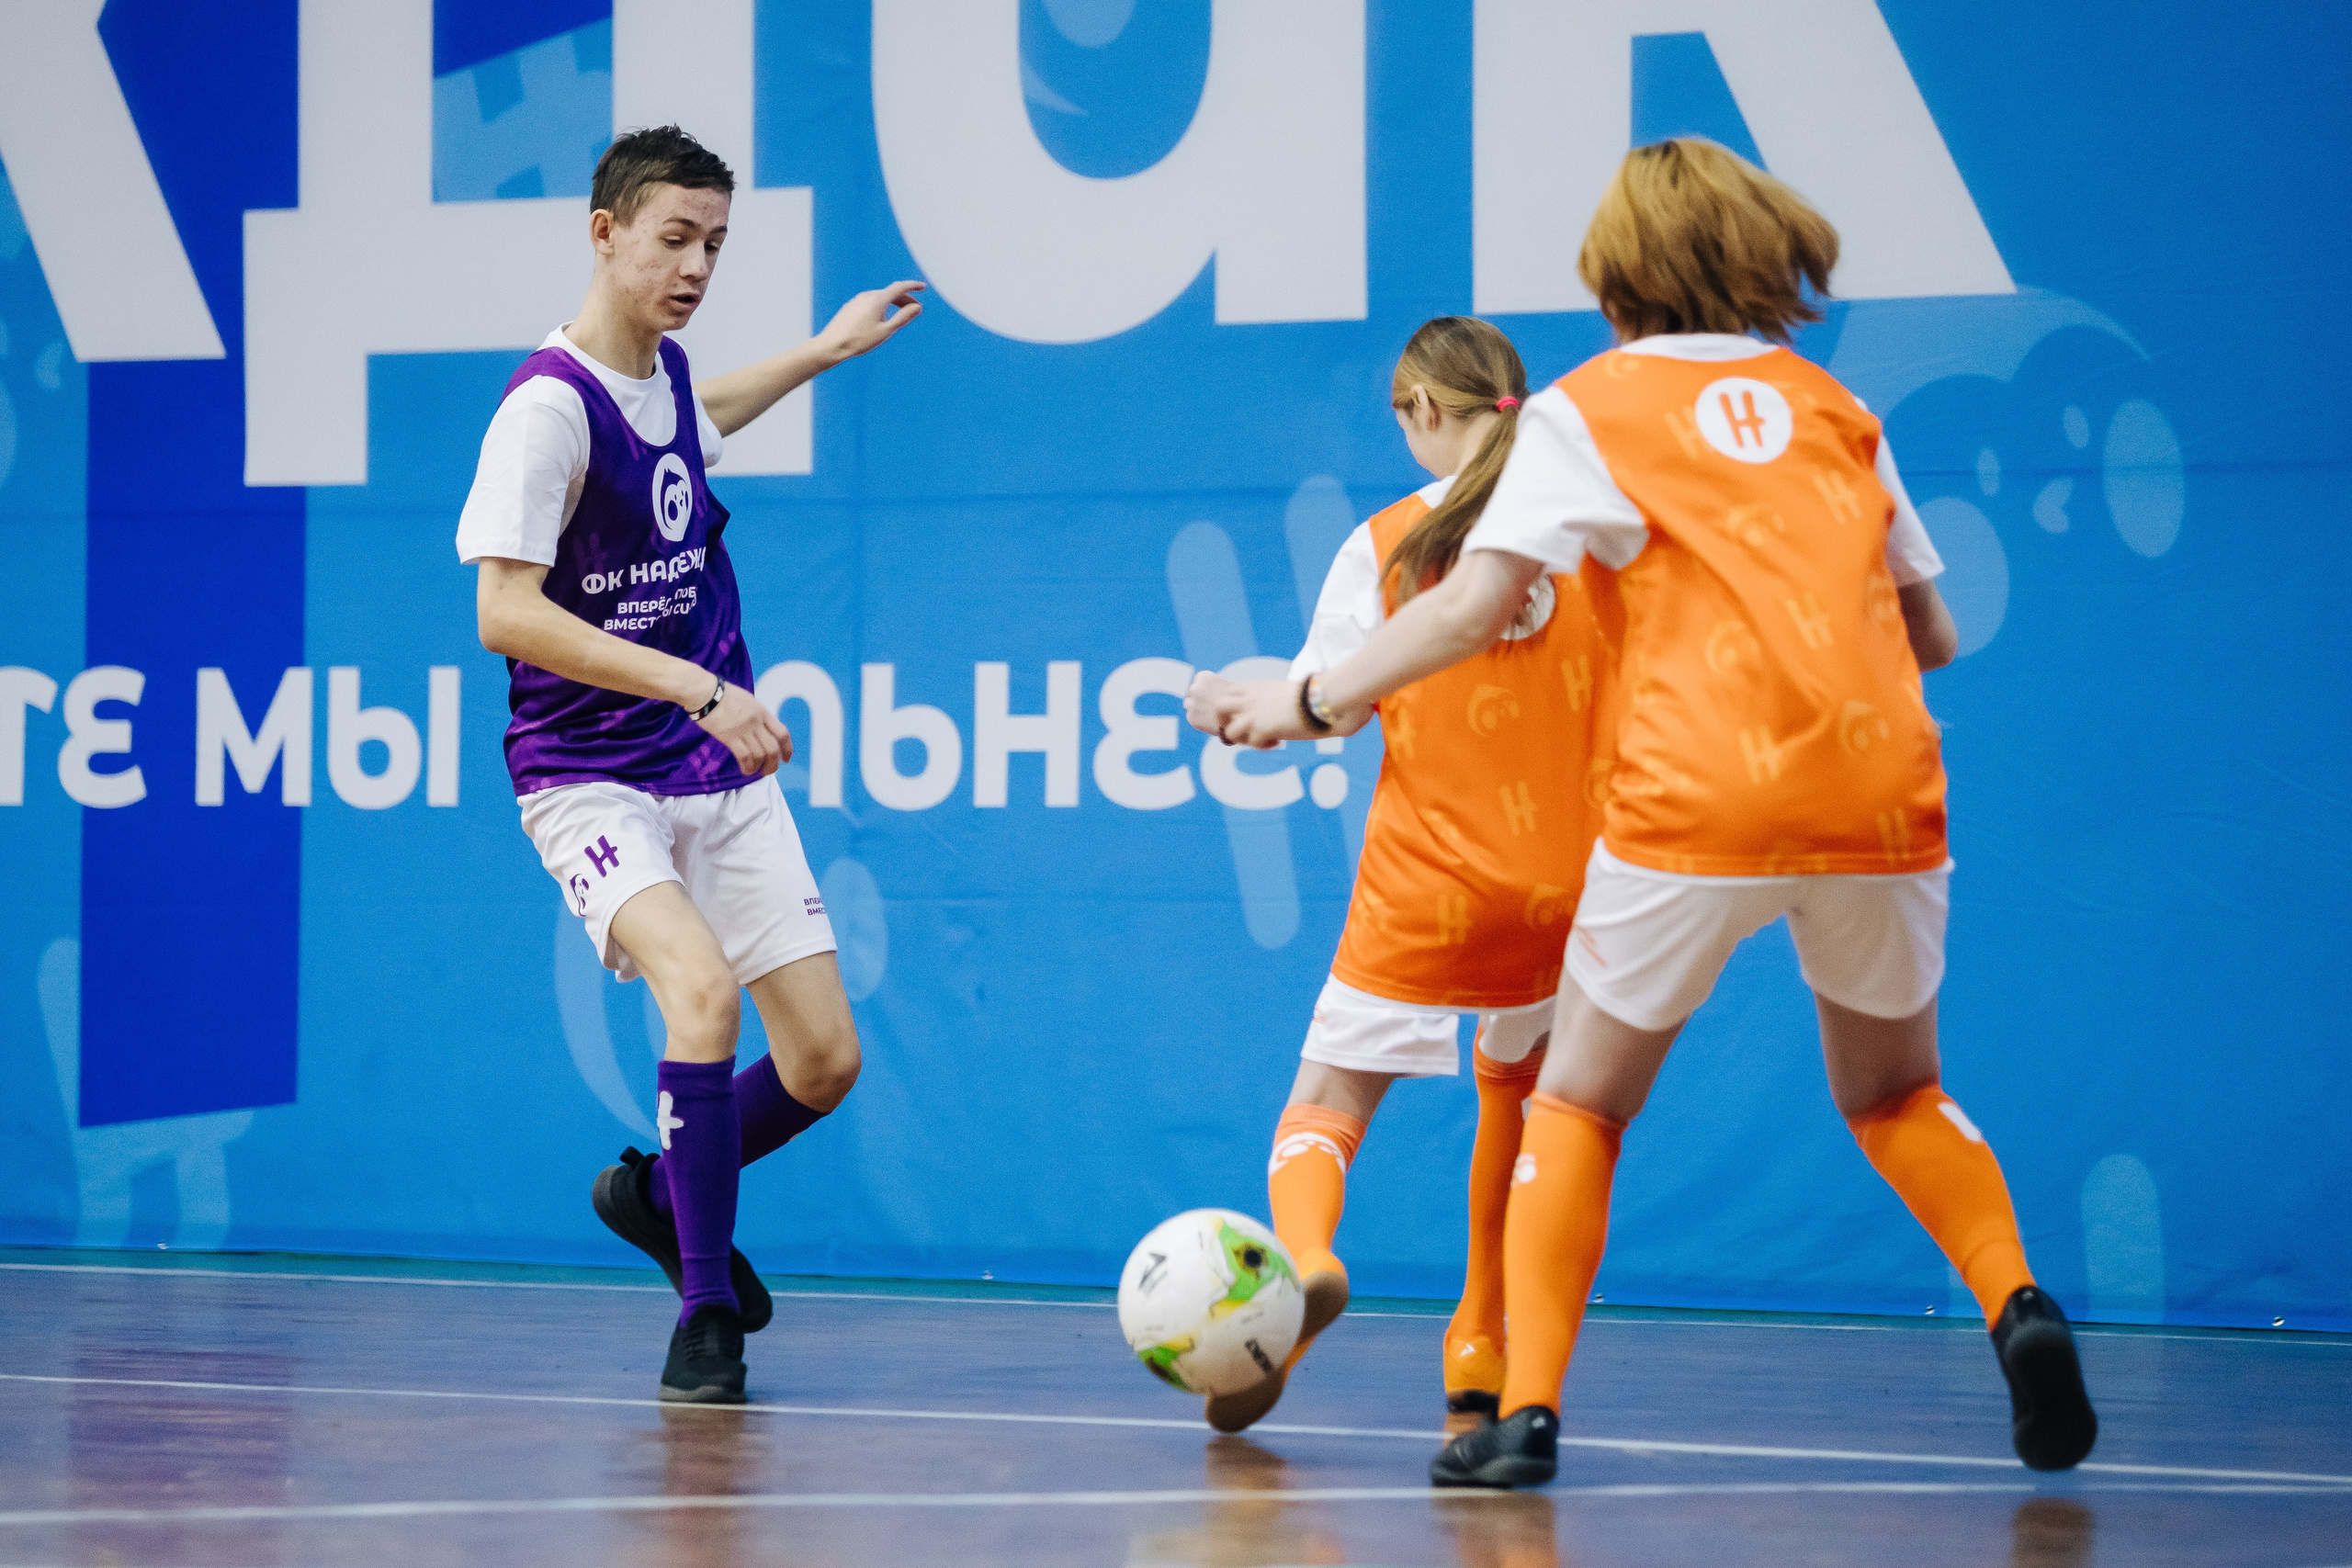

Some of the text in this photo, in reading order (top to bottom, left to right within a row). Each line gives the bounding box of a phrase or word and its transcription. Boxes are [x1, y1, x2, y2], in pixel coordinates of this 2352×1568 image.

[582, 547, 706, 594] ФК НАДЕЖ
[604, 615, 662, 631] ВМЕСТ
[195, 665, 460, 808] МЫ
